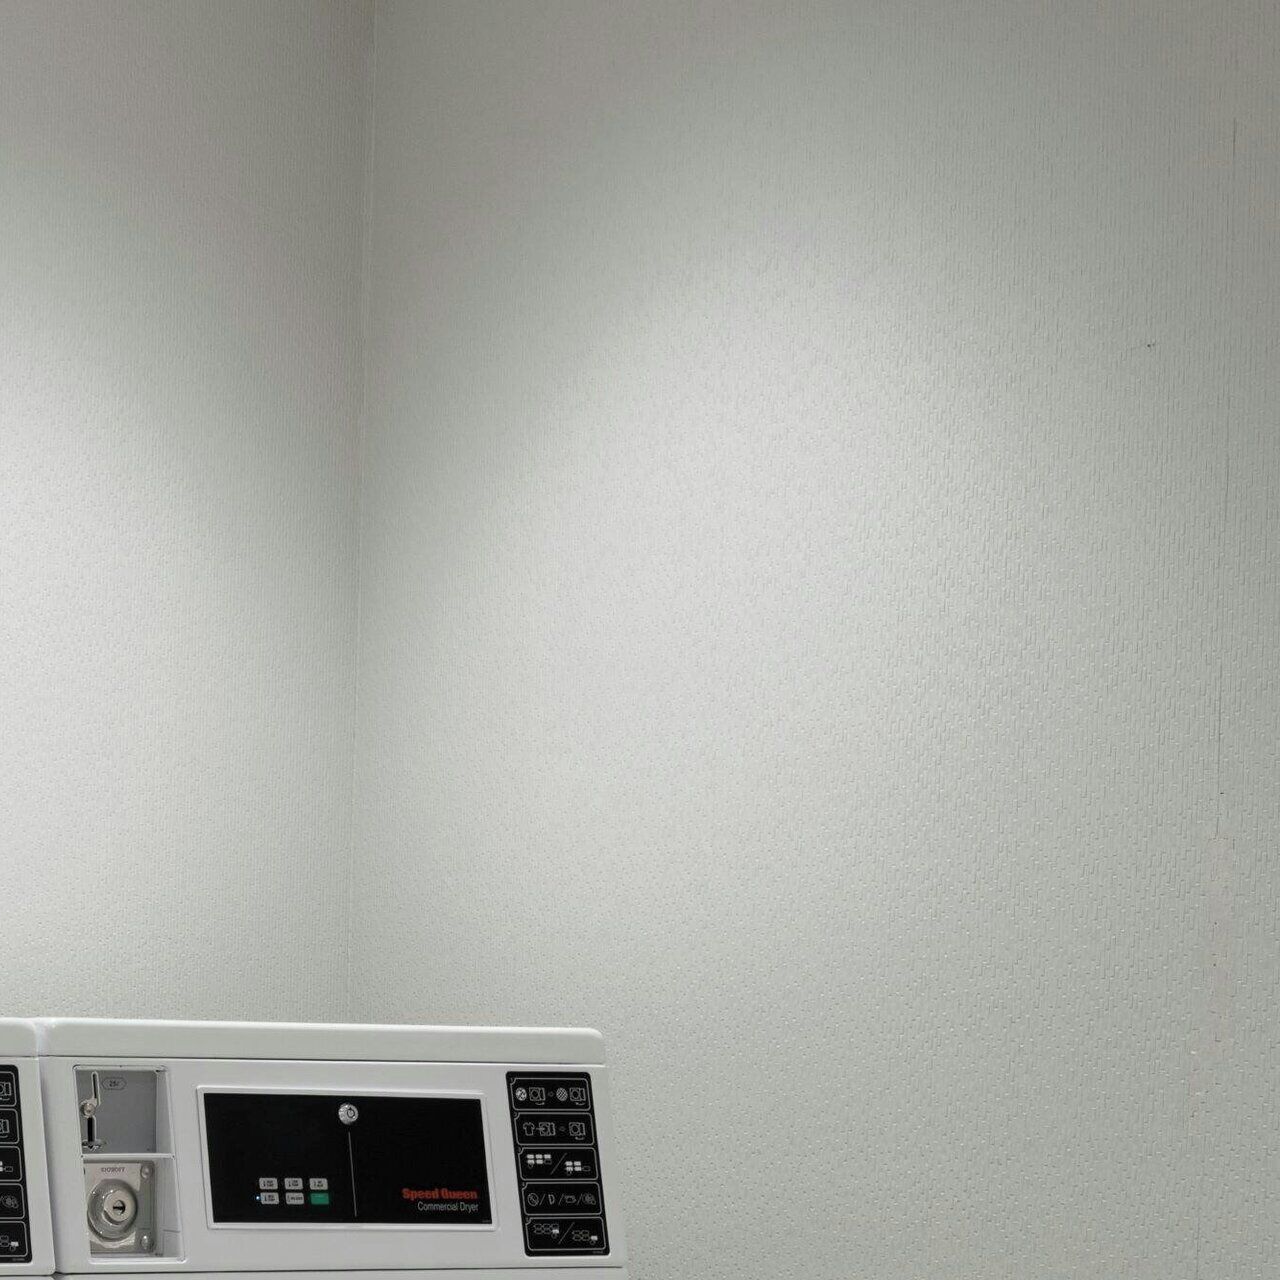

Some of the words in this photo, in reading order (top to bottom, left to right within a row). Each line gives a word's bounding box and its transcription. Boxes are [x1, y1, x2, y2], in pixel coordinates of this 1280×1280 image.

[402, 1188, 439, 1200] Speed
[441, 1188, 478, 1199] Queen
[417, 1201, 458, 1211] Commercial
[460, 1202, 479, 1213] Dryer
